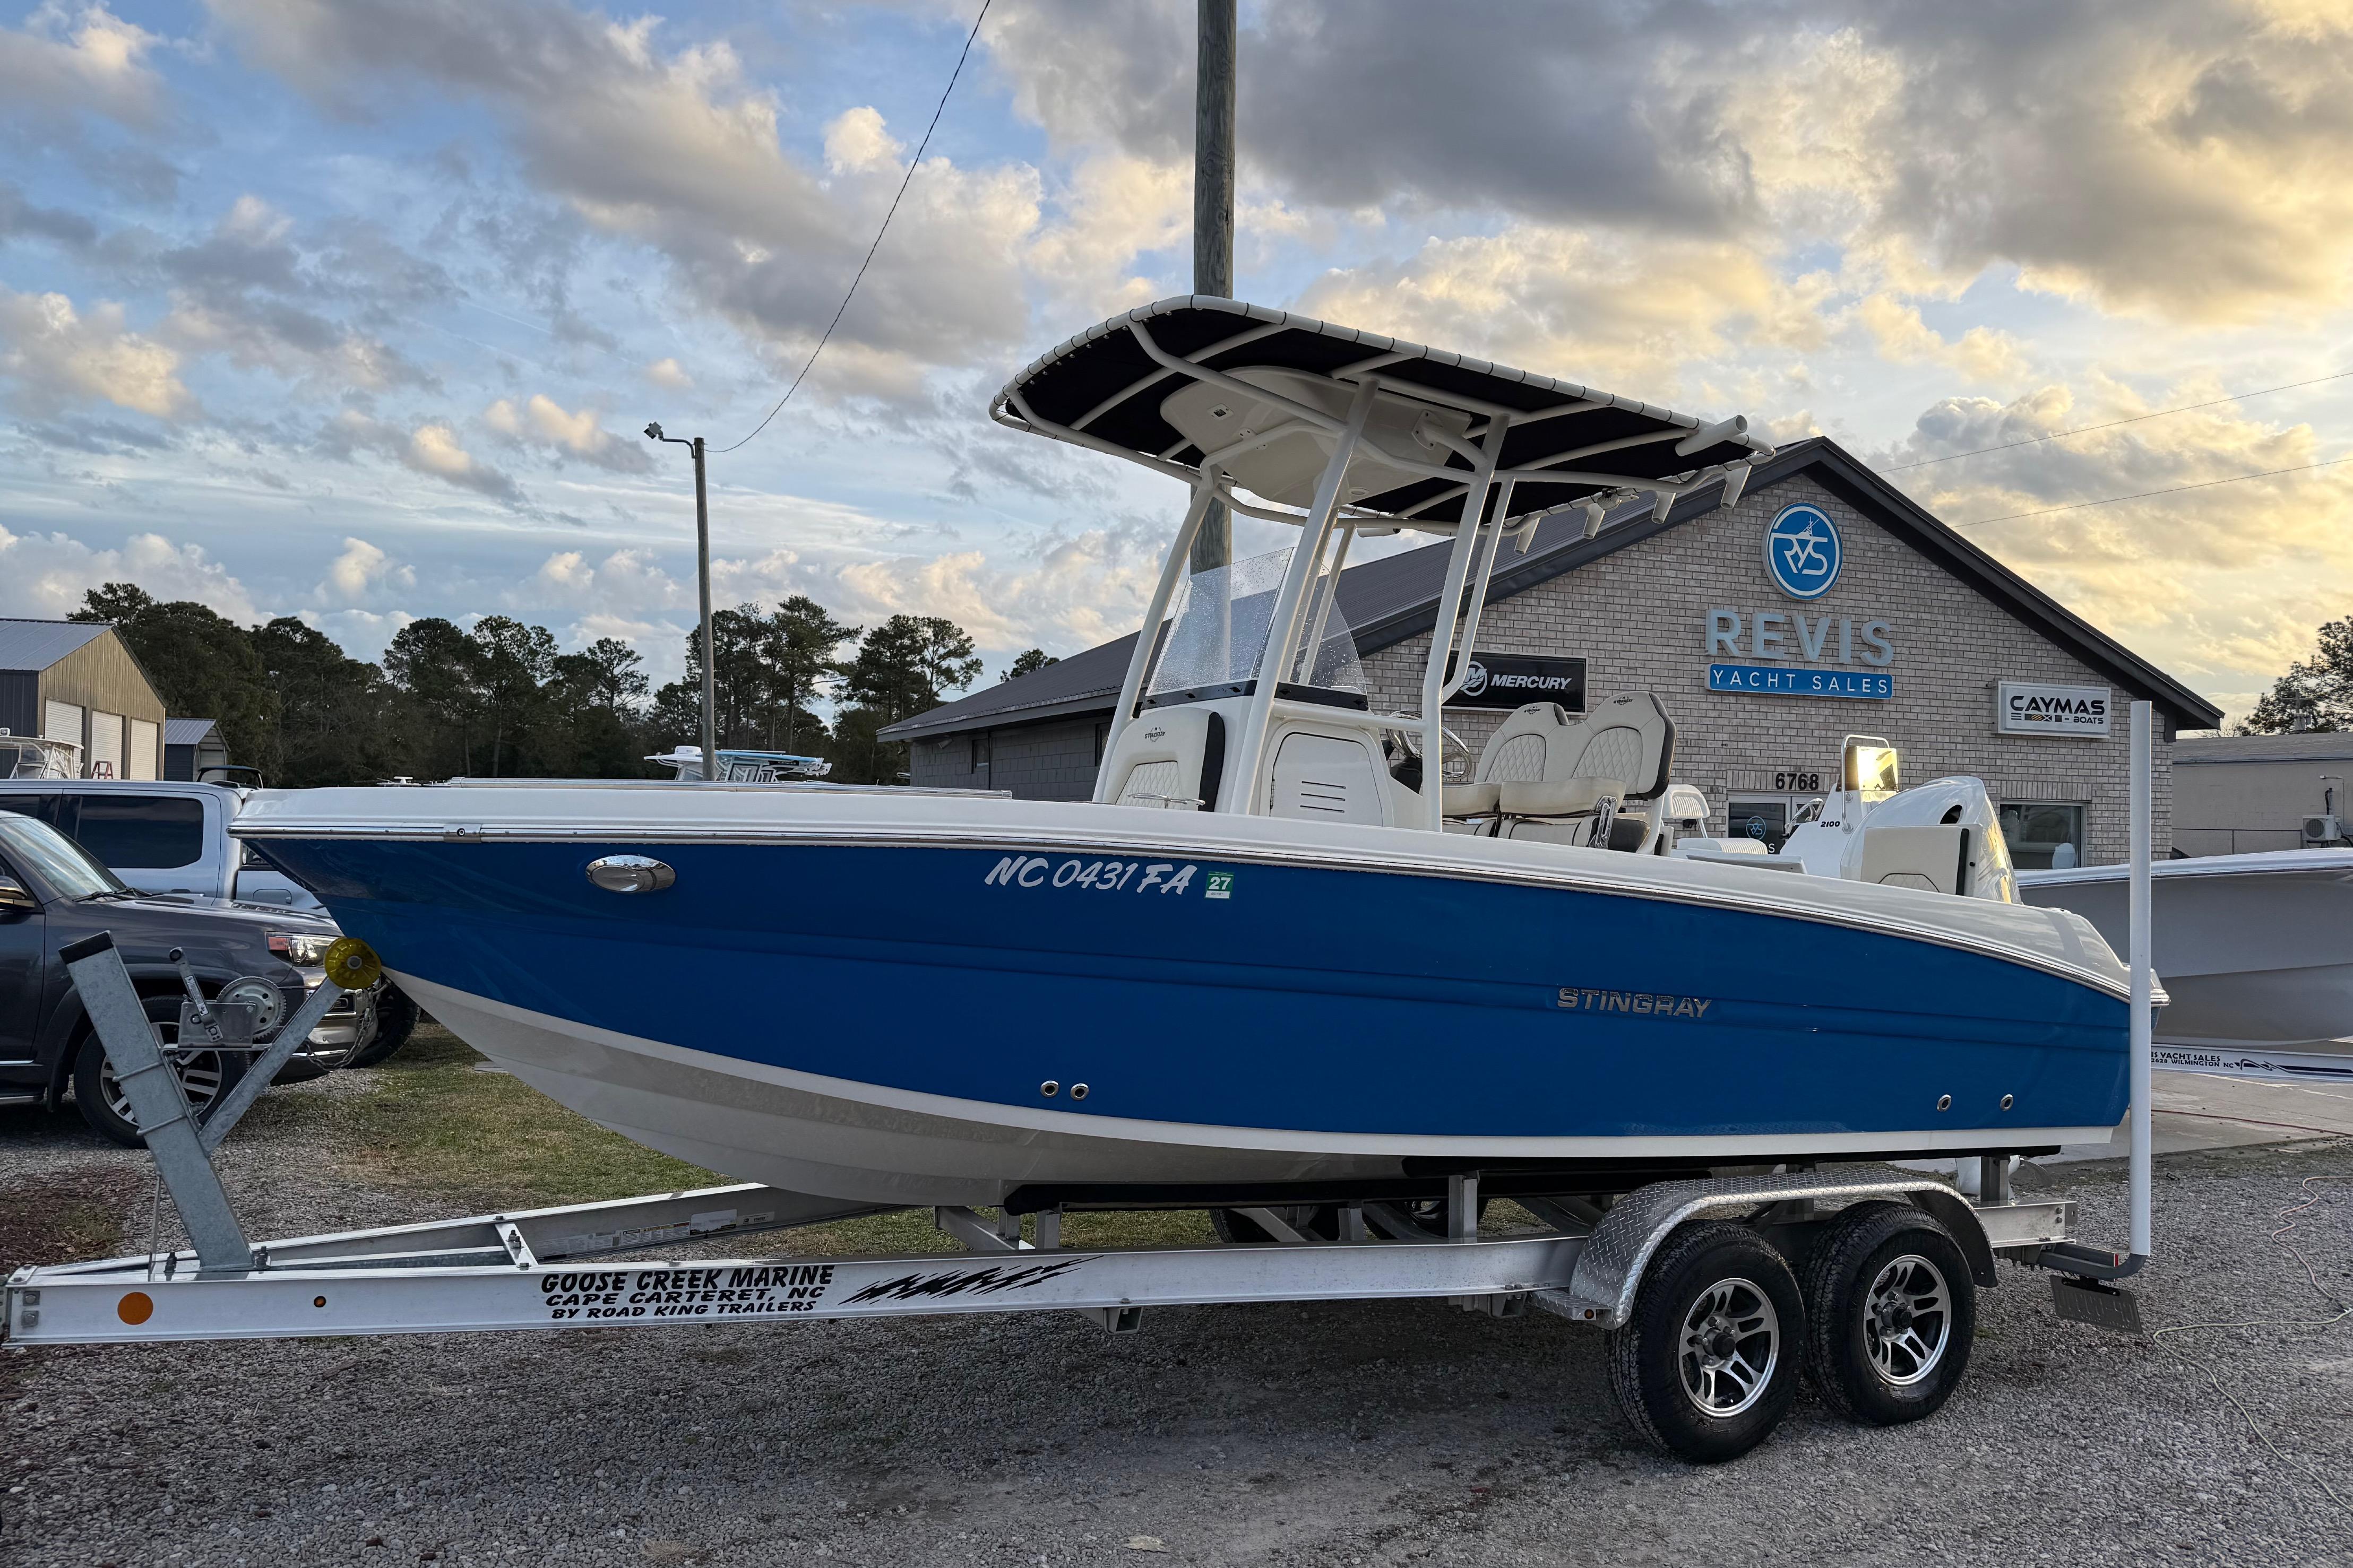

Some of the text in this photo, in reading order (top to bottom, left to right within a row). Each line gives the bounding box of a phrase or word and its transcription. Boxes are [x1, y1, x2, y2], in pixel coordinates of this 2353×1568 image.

[1705, 609, 1893, 666] REVIS
[1490, 674, 1572, 690] MERCURY
[1713, 670, 1887, 694] YACHT SALES
[2010, 695, 2105, 715] CAYMAS
[2073, 716, 2104, 724] BOATS
[1775, 773, 1819, 791] 6768
[984, 855, 1198, 895] NC 0431 FA
[1209, 876, 1231, 890] 27
[1557, 987, 1712, 1018] STINGRAY
[2160, 1052, 2192, 1060] YACHT
[541, 1264, 835, 1293] GOOSE CREEK MARINE
[546, 1286, 826, 1307] CAPE CARTERET, NC
[551, 1300, 817, 1319] BY ROAD KING TRAILERS
